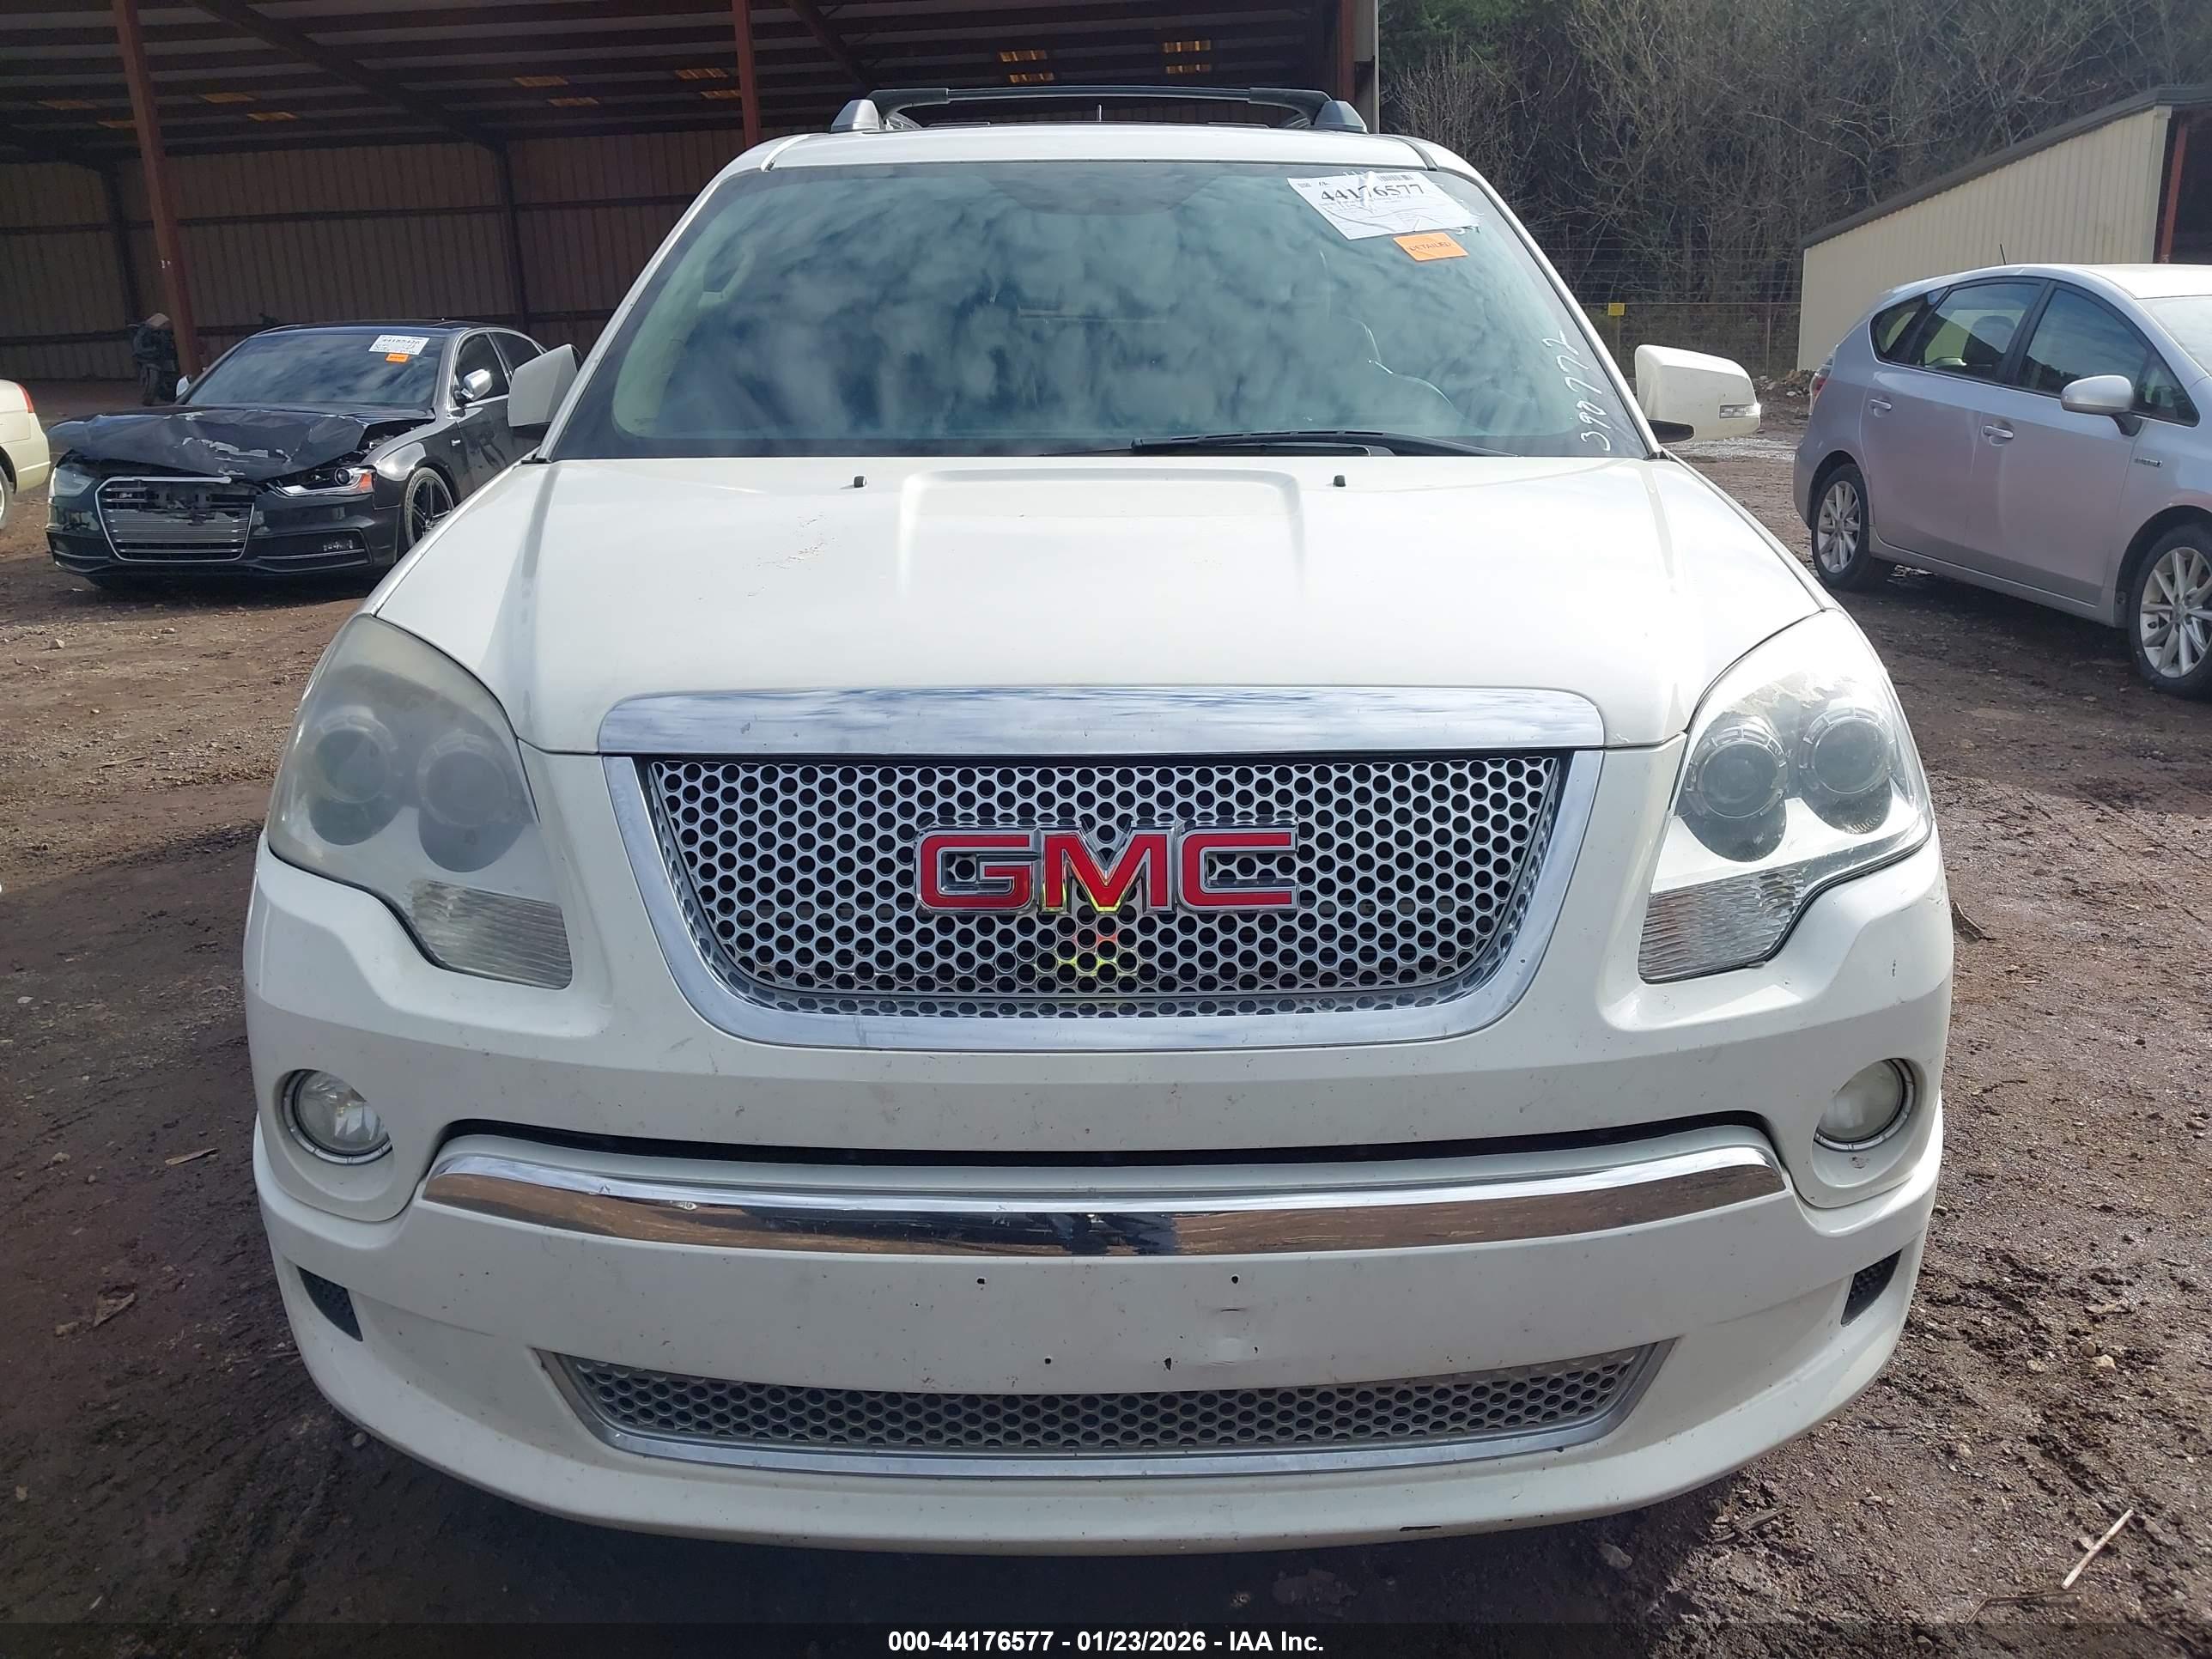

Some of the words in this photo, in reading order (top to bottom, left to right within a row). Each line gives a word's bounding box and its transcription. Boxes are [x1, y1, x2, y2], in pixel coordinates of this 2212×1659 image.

[1321, 183, 1425, 202] 44176577
[1408, 240, 1452, 252] DETAILED
[916, 826, 1298, 913] GMC
